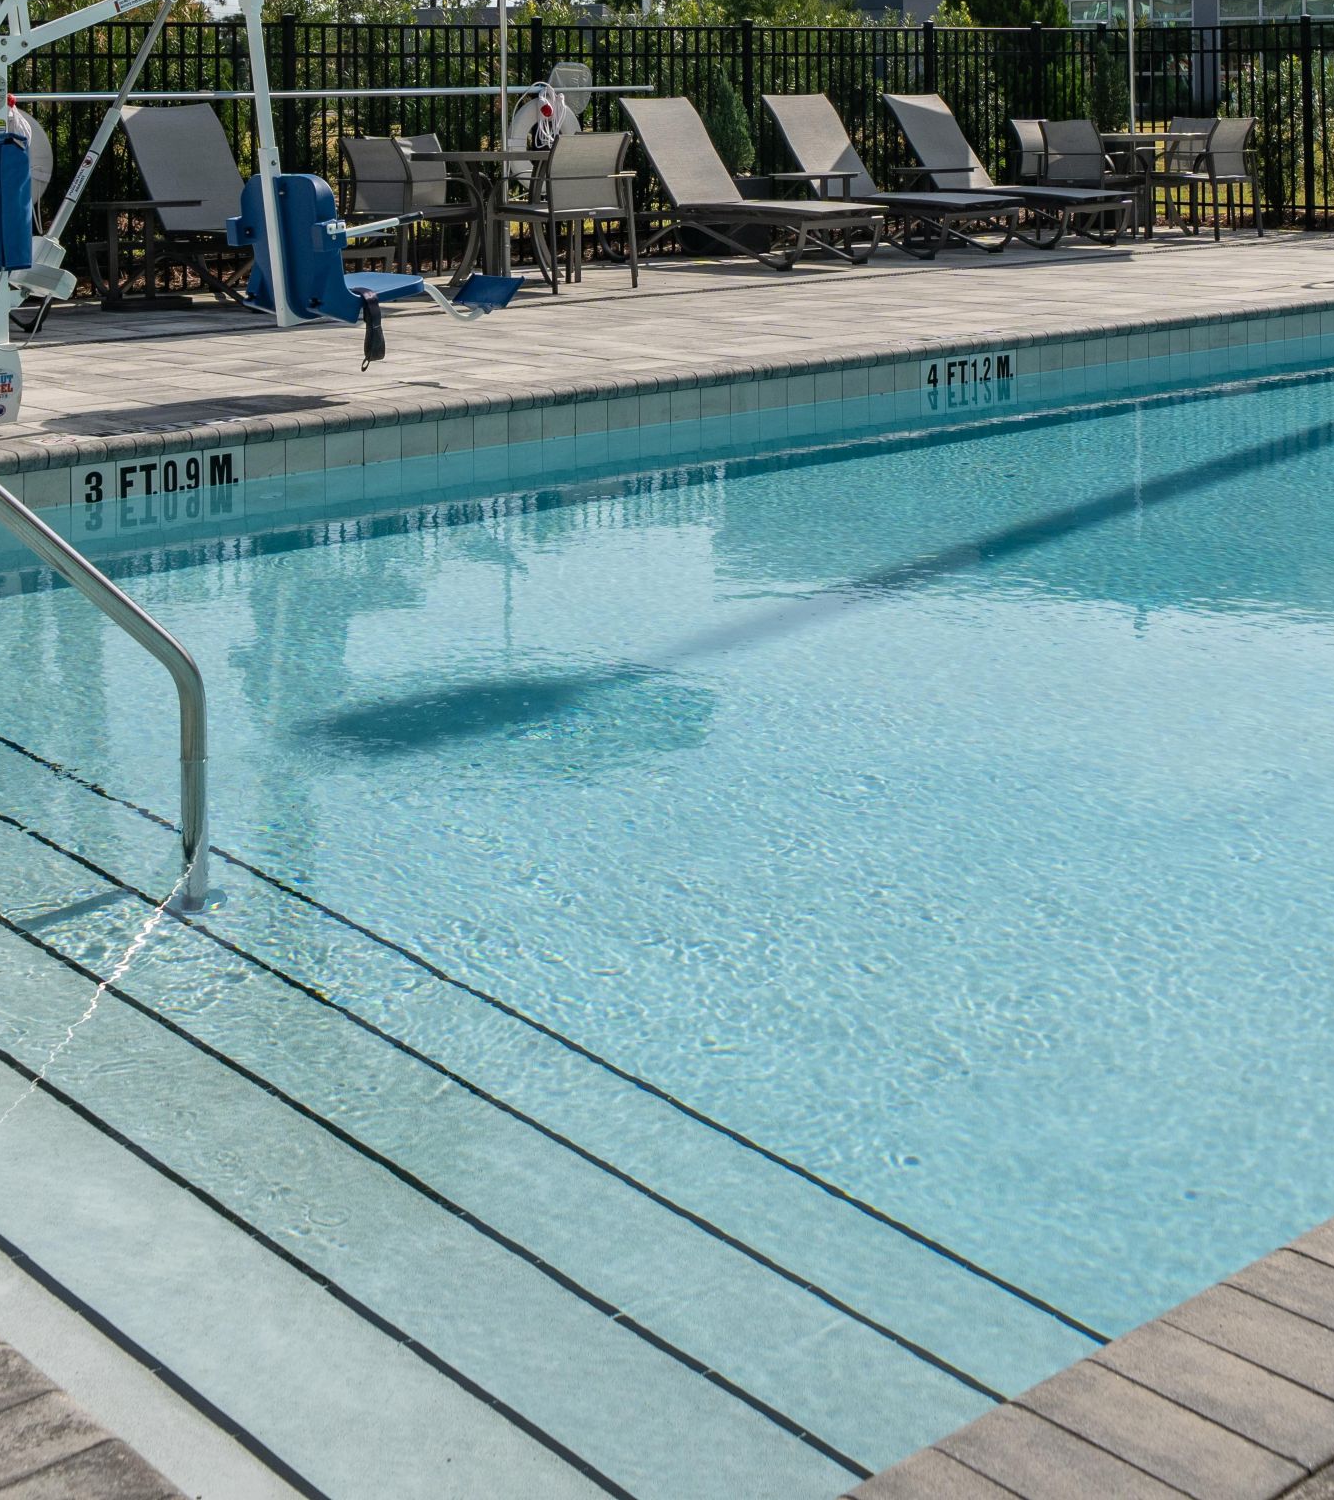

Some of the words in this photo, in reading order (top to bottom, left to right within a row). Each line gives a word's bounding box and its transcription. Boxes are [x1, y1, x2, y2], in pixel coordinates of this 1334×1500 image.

[927, 364, 938, 388] 4
[947, 360, 969, 386] FT.
[971, 357, 991, 382] 1.2
[997, 355, 1013, 379] M.
[85, 472, 103, 504] 3
[119, 463, 158, 500] FT.
[163, 458, 200, 493] 0.9
[209, 453, 239, 486] M.
